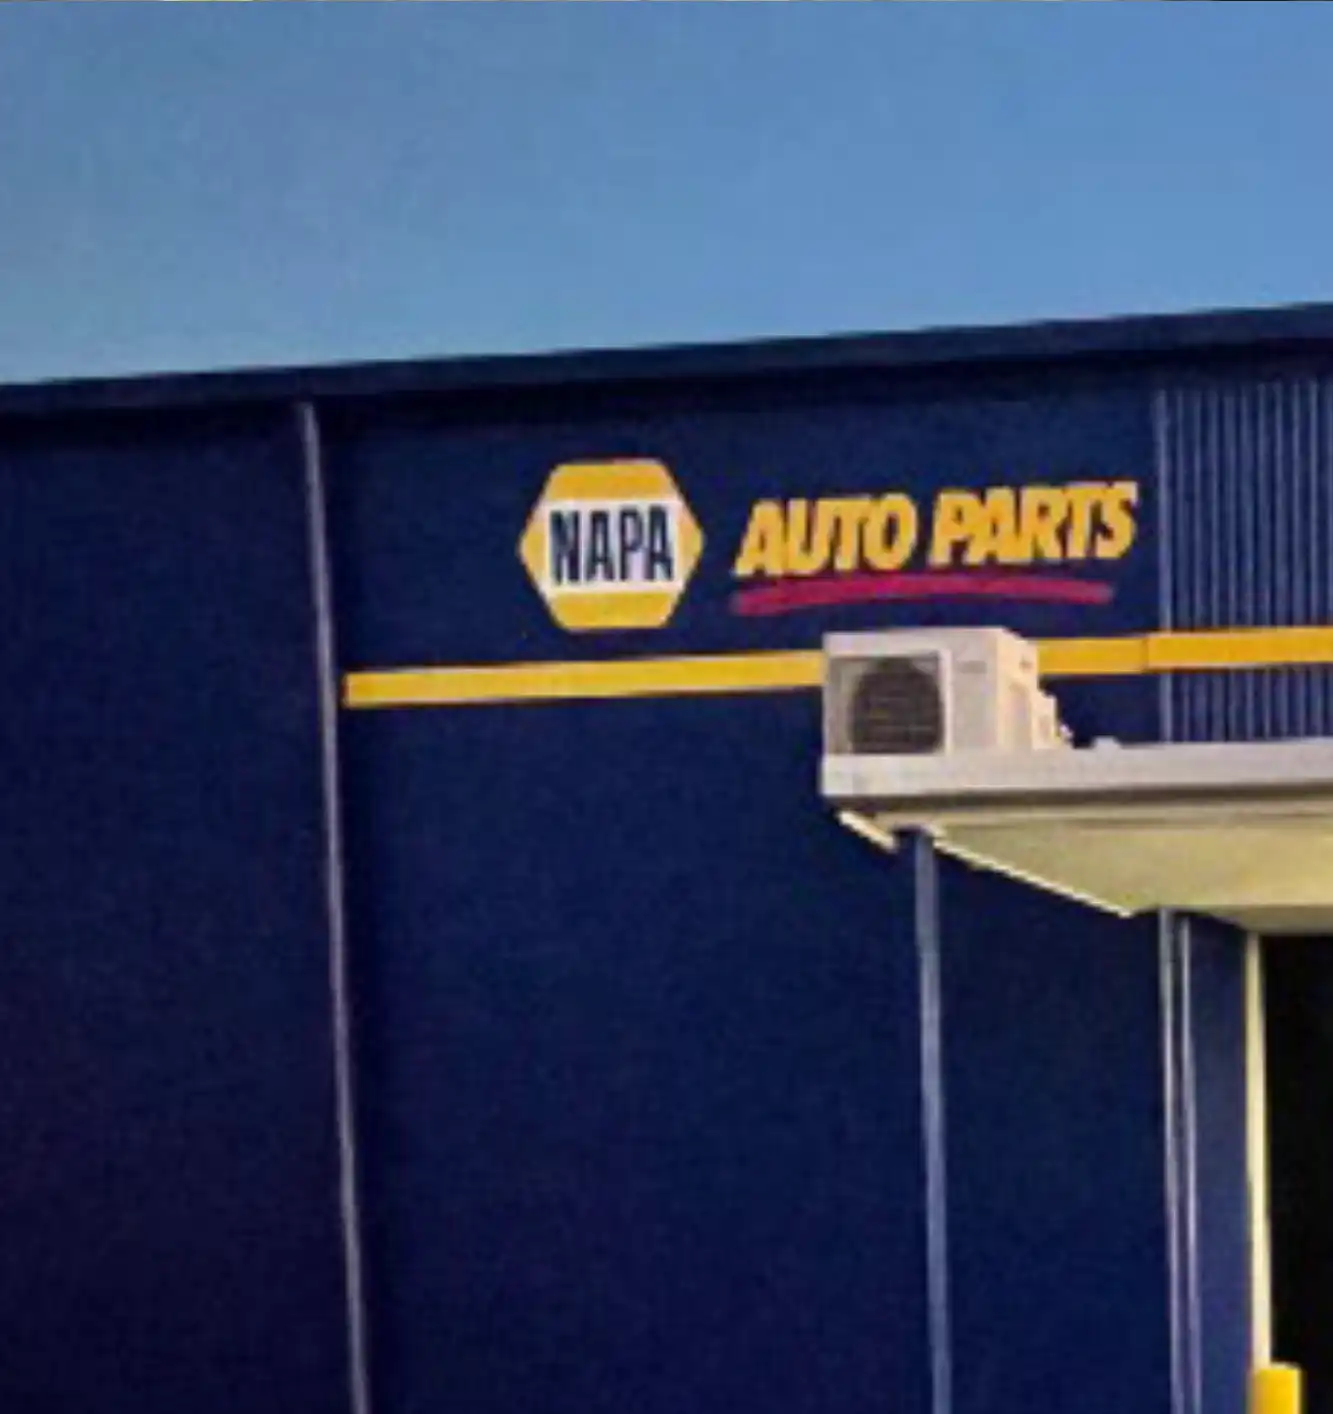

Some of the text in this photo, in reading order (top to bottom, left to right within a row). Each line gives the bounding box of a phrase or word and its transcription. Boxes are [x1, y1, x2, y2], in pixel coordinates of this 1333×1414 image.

[548, 505, 675, 586] NAPA
[732, 481, 1138, 577] AUTO PARTS
